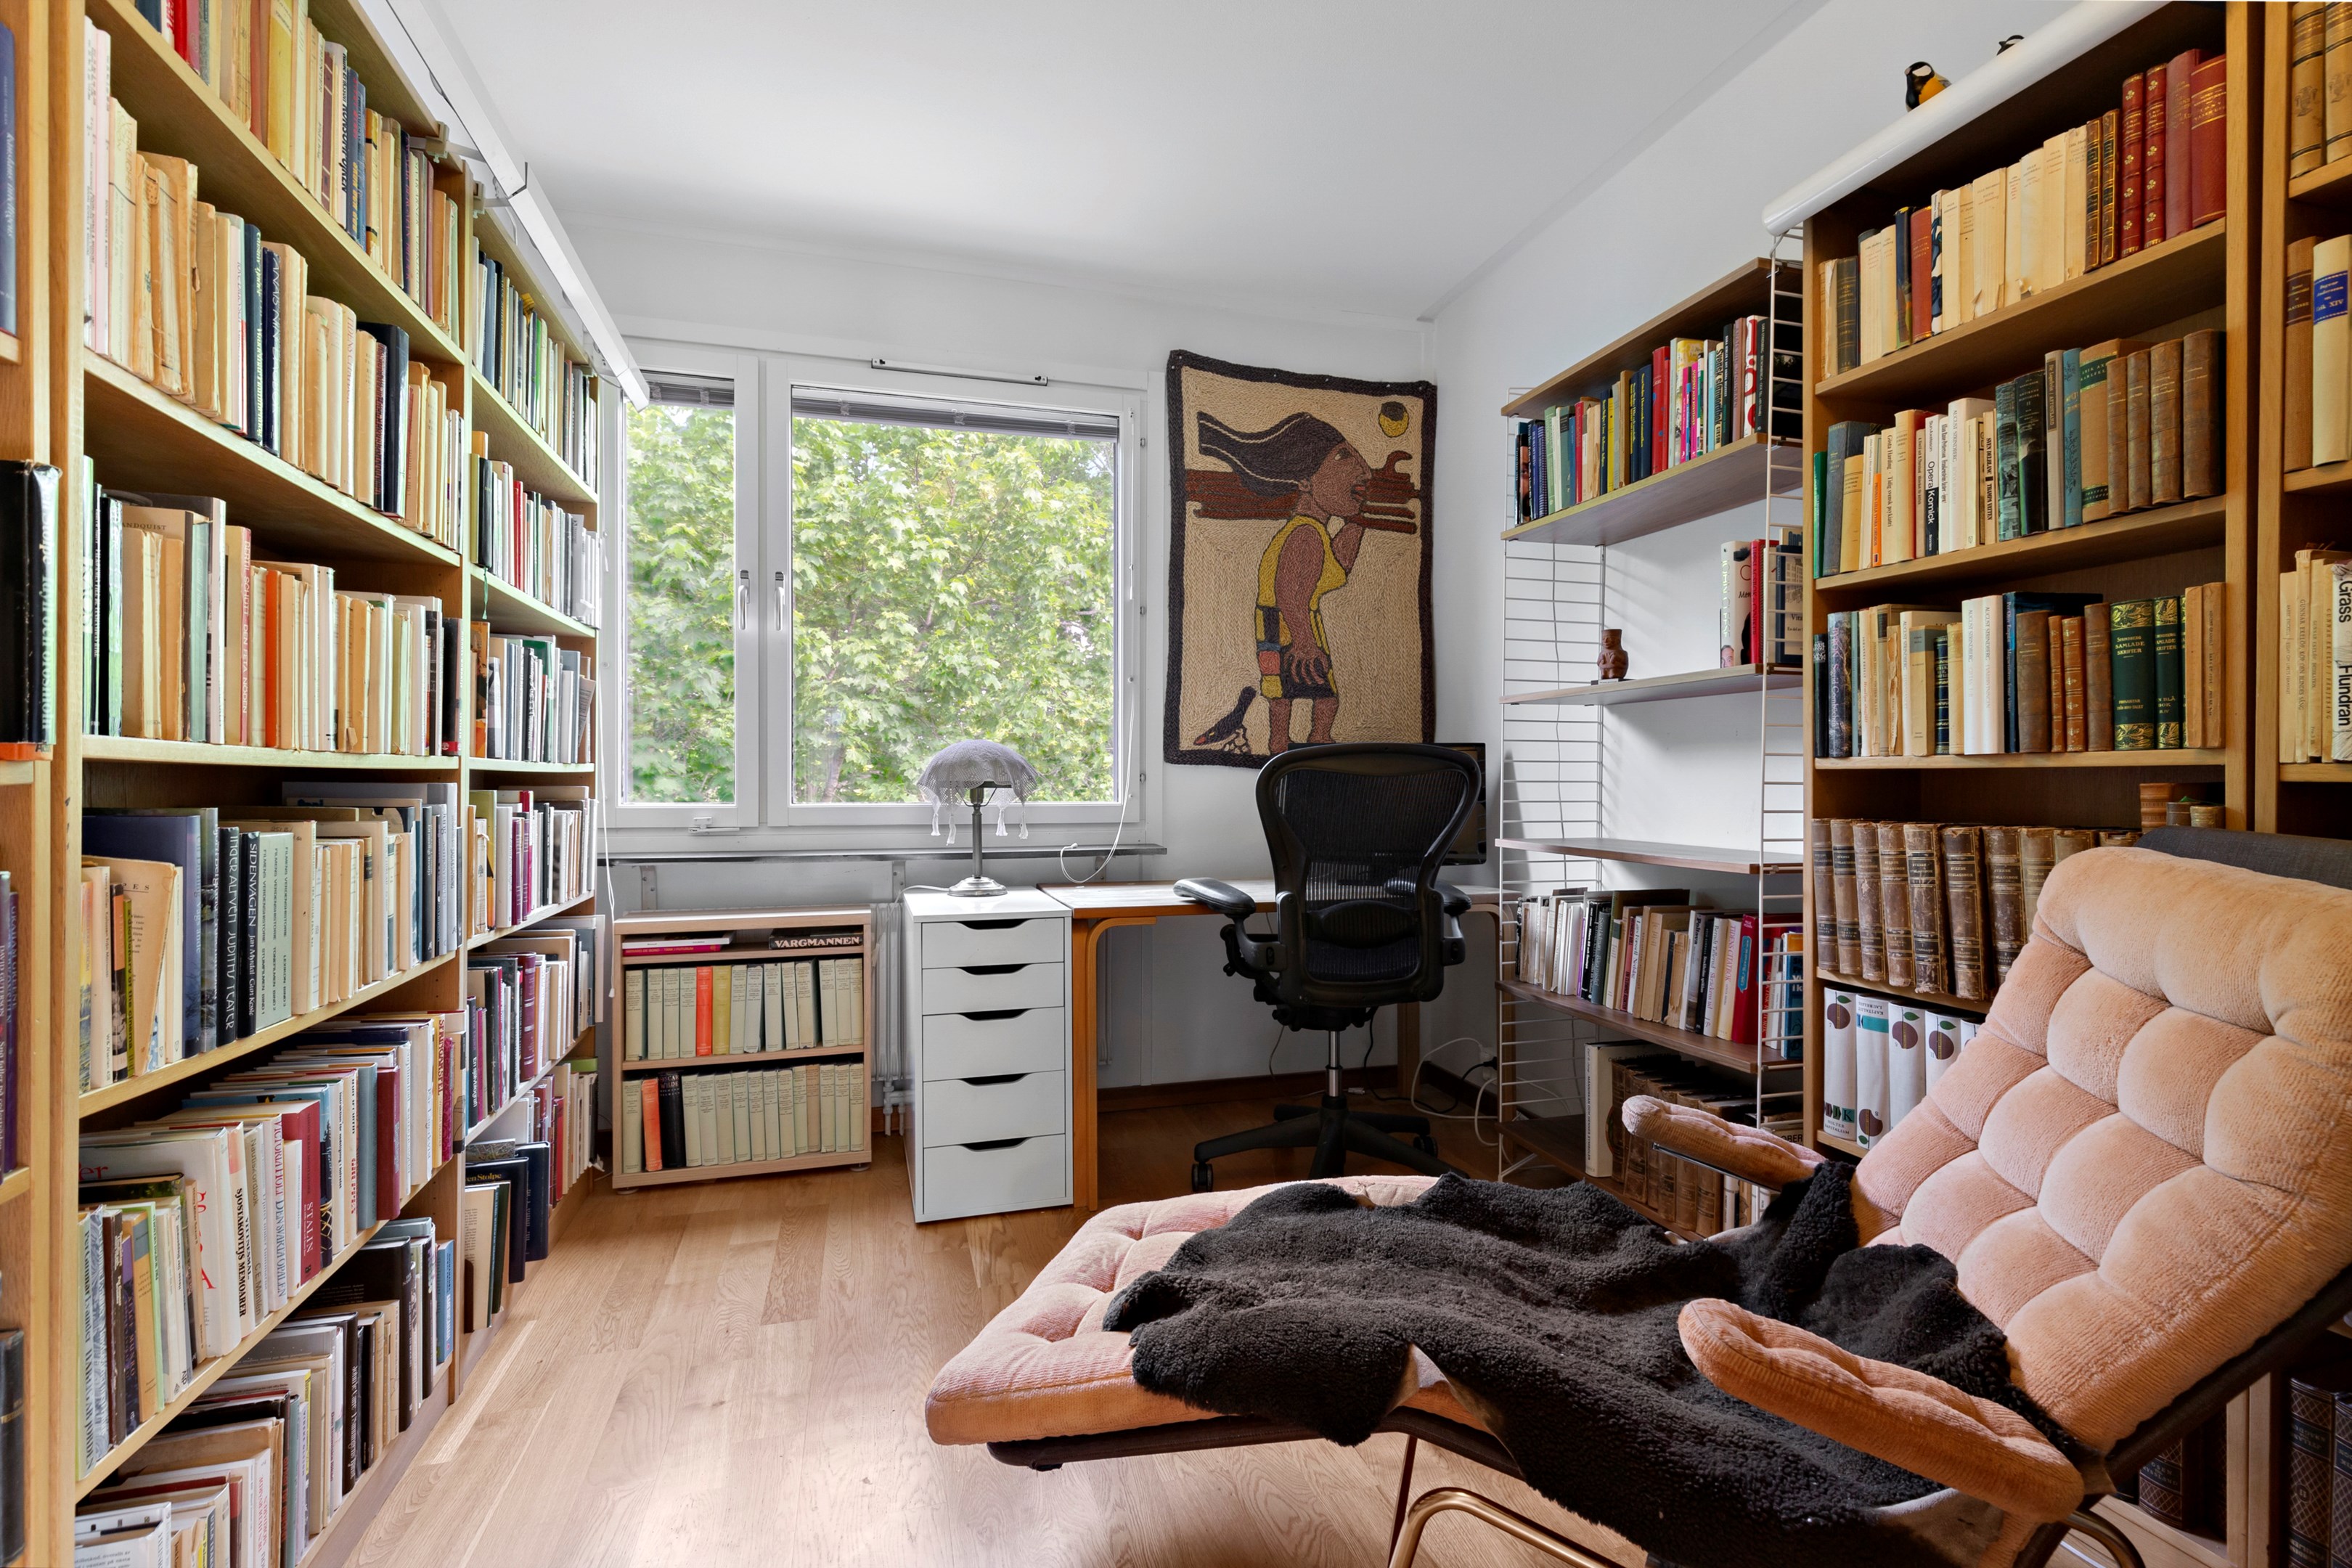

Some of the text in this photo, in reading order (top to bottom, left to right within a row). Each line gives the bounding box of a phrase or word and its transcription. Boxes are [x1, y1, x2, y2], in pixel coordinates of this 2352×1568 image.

[1715, 348, 1724, 377] Svensk
[1927, 461, 1935, 525] Opera Komick
[1721, 560, 1730, 594] JOHN
[2338, 581, 2352, 623] Grass
[41, 616, 52, 647] och
[2115, 641, 2145, 650] SAMLADE
[2338, 664, 2352, 727] Flundran
[228, 836, 238, 872] INGER
[775, 936, 859, 948] VARGMANNEN
[247, 948, 256, 976] Myrdal
[1725, 949, 1734, 982] CITATBOK
[1707, 971, 1716, 1000] Skräckens
[225, 985, 235, 1031] TEATER
[1843, 1110, 1854, 1122] K
[274, 1119, 284, 1196] VICTORIA HOLT
[275, 1199, 287, 1298] DEN SVARTA OPALEN
[237, 1262, 247, 1318] MEMOARER
